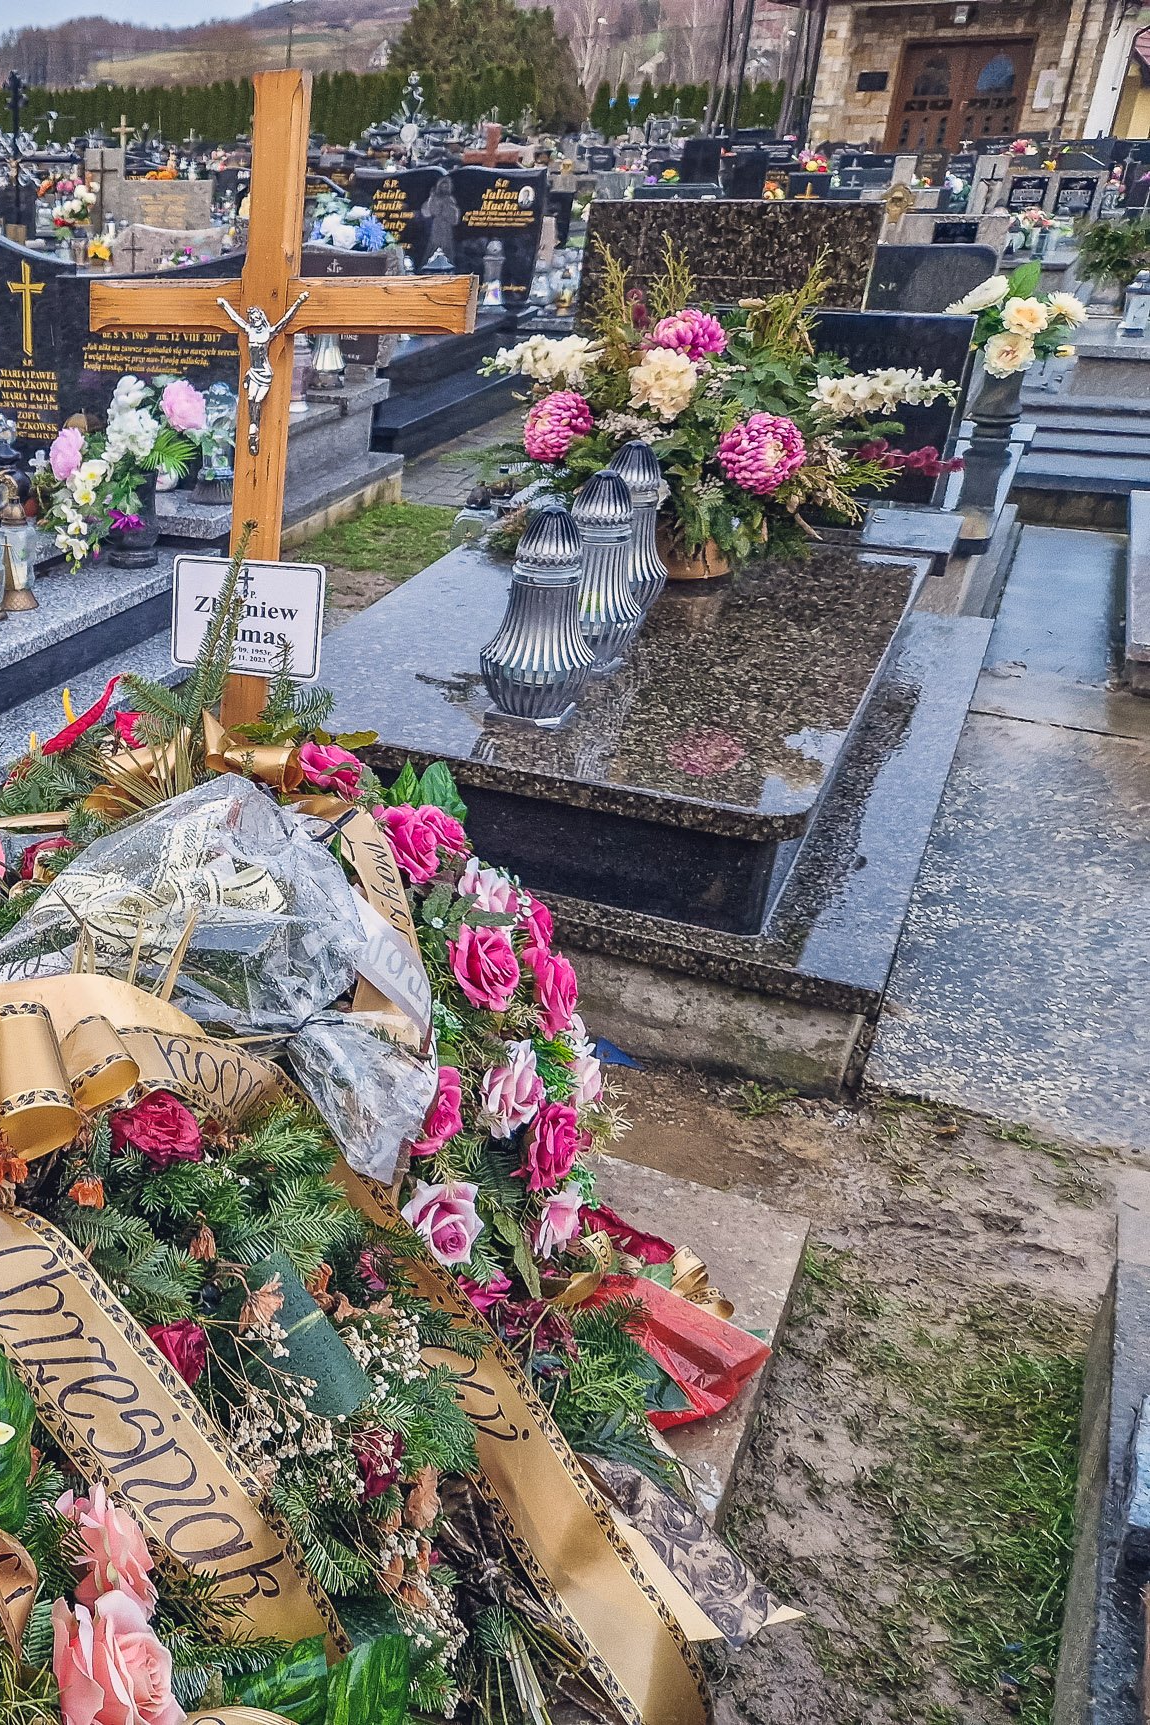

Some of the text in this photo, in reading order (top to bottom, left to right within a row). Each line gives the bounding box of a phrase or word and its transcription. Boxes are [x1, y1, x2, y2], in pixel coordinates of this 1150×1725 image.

[481, 188, 519, 200] Julian
[170, 333, 181, 341] 12
[183, 333, 200, 342] VIII
[203, 333, 222, 342] 2017
[0, 367, 26, 379] MARIA
[1, 390, 28, 401] MARIA
[17, 411, 41, 420] ZOFIA
